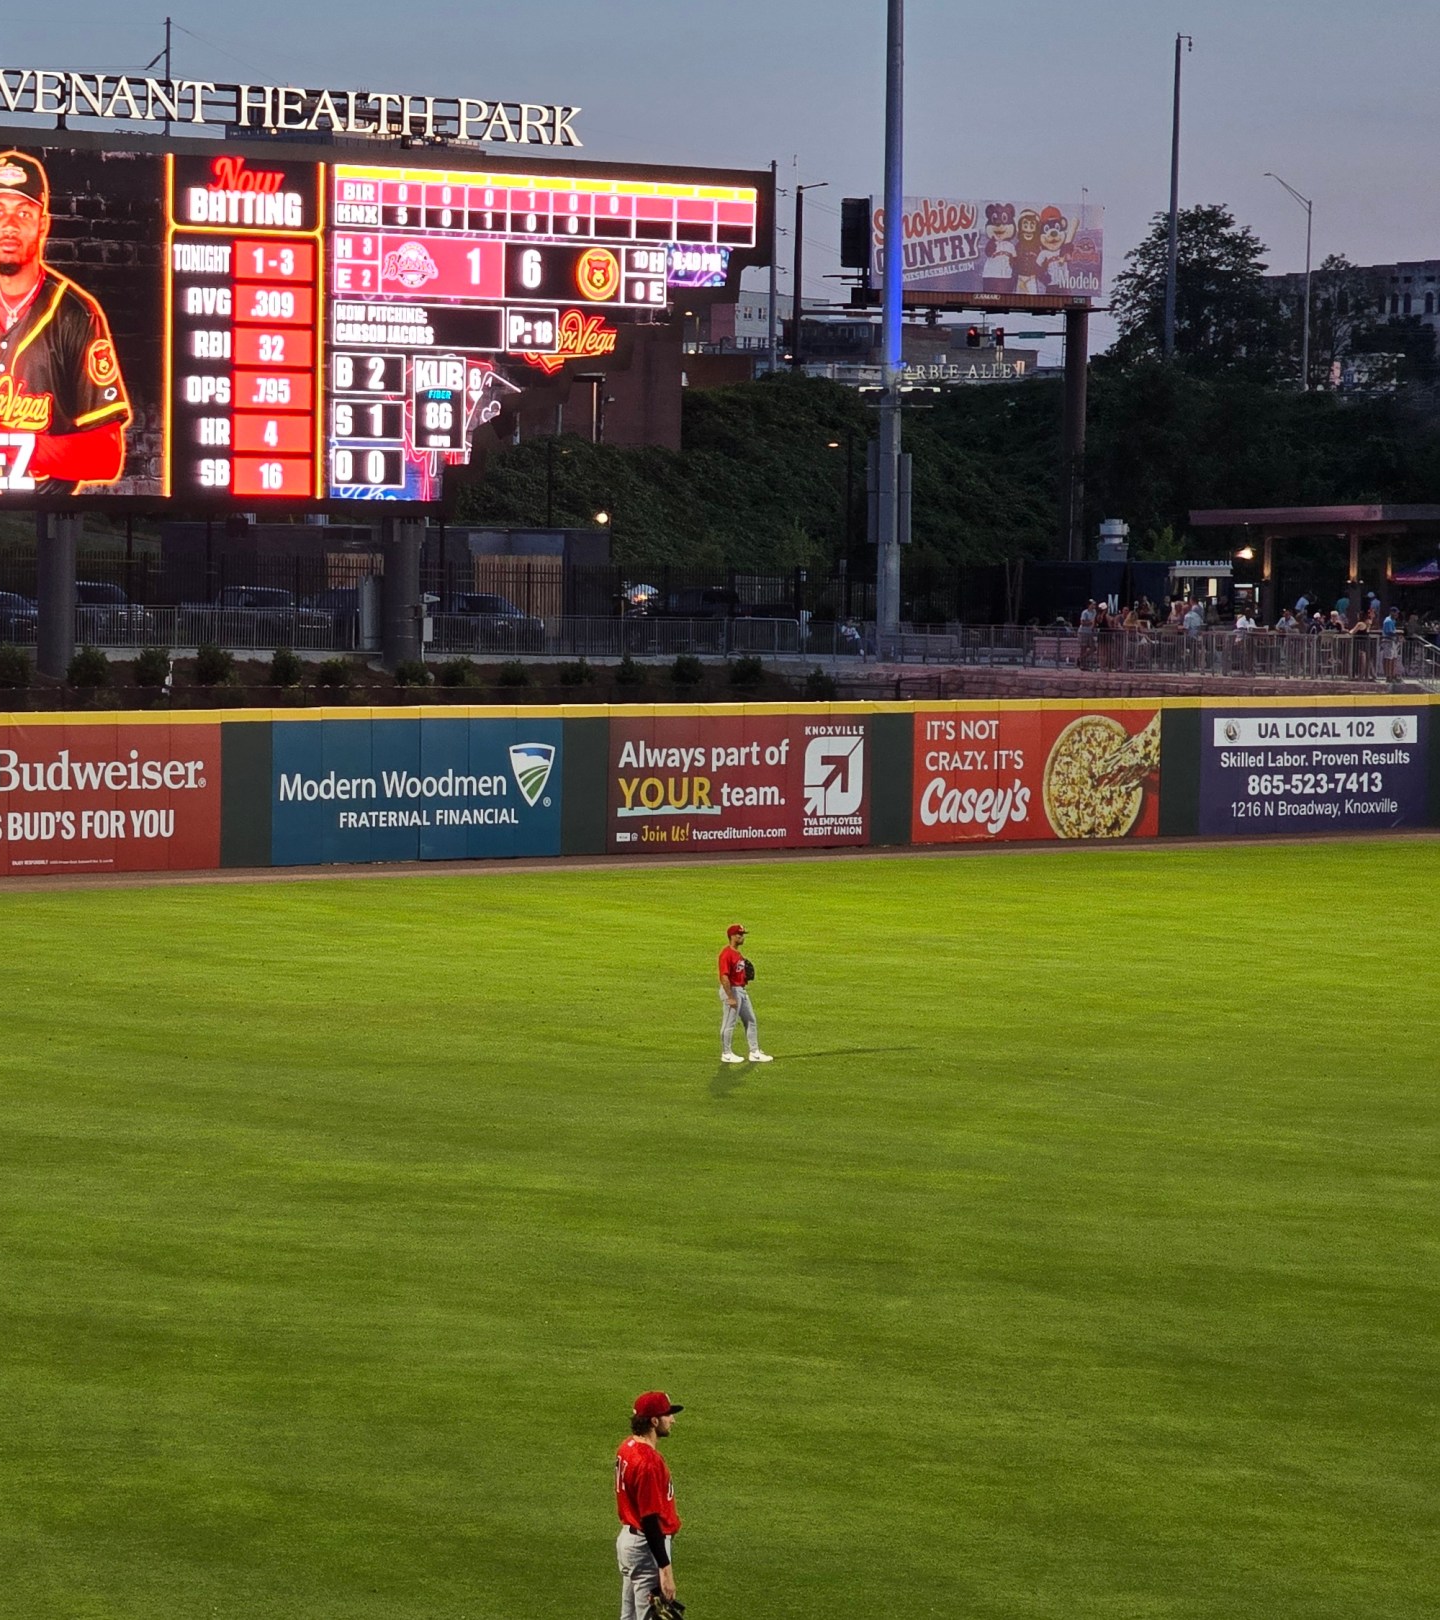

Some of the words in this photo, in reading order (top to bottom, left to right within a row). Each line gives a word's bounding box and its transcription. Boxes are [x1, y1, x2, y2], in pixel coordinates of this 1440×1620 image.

[239, 84, 435, 137] HEALTH
[457, 97, 584, 147] PARK
[208, 156, 284, 194] Now
[190, 187, 302, 226] BATTING
[343, 182, 374, 201] BIR
[398, 184, 408, 202] 0
[441, 186, 451, 205] 0
[485, 189, 494, 207] 0
[527, 191, 535, 209] 1
[569, 194, 578, 212] 0
[610, 196, 619, 214] 0
[338, 204, 378, 224] KNX
[397, 206, 408, 225] 5
[441, 209, 451, 227] 0
[483, 212, 492, 229] 1
[526, 213, 536, 232] 0
[568, 216, 578, 234] 0
[873, 199, 976, 246] Sokies
[173, 244, 231, 273] TONIGHT
[337, 238, 352, 258] H
[363, 237, 372, 255] 3
[632, 251, 648, 269] 10
[649, 252, 664, 272] H
[876, 232, 978, 275] CUNTRY
[337, 269, 351, 288] E
[362, 269, 371, 287] 2
[466, 248, 480, 285] 1
[522, 249, 542, 288] 6
[1058, 269, 1099, 290] Modelo
[188, 288, 231, 315] AVG
[250, 291, 294, 317] .309
[635, 281, 645, 300] 0
[649, 282, 664, 301] E
[336, 304, 366, 321] NOW
[367, 305, 428, 324] PITCHING:
[194, 331, 231, 358] RBI
[259, 335, 285, 361] 32
[336, 356, 353, 388] B
[368, 357, 385, 389] 2
[416, 360, 463, 390] KUB
[469, 368, 481, 389] 6
[905, 365, 959, 380] ARBLE
[967, 364, 1022, 378] ALLEY
[187, 376, 231, 403] OPS
[252, 378, 290, 404] .795
[336, 404, 353, 436] S
[369, 404, 383, 436] 1
[426, 402, 452, 429] 86
[200, 418, 230, 445] HR
[264, 420, 278, 447] 4
[200, 459, 230, 486] SB
[259, 462, 283, 489] 16
[805, 725, 865, 735] KNOXVILLE
[926, 720, 955, 740] IT'S
[961, 720, 999, 740] NOT
[1258, 723, 1280, 738] UA
[1286, 722, 1340, 738] LOCAL
[1346, 721, 1375, 737] 102
[618, 740, 705, 772] Always
[712, 741, 759, 772] part
[765, 738, 789, 766] of
[926, 751, 989, 771] CRAZY.
[993, 750, 1024, 769] IT'S
[1220, 752, 1264, 767] Skilled
[1268, 751, 1309, 767] Labor.
[1312, 750, 1359, 766] Proven
[1363, 749, 1410, 764] Results
[279, 771, 376, 801] Modern
[382, 769, 507, 798] Woodmen
[618, 776, 712, 810] YOUR
[721, 782, 786, 807] team.
[1247, 772, 1383, 795] 865-523-7413
[339, 810, 430, 828] FRATERNAL
[436, 808, 519, 826] FINANCIAL
[920, 777, 1031, 833] Casey's
[1231, 802, 1260, 817] 1216
[1264, 801, 1274, 816] N
[1278, 799, 1341, 818] Broadway,
[1345, 798, 1398, 814] Knoxville
[8, 811, 76, 841] BUD'S
[81, 810, 125, 839] FOR
[130, 809, 175, 838] YOU
[641, 825, 667, 842] Join
[671, 822, 690, 842] Us!
[692, 826, 786, 841] tvacreditunion.com
[803, 818, 818, 826] TVA
[819, 816, 862, 825] EMPLOYEES
[803, 827, 831, 836] CREDIT
[833, 826, 862, 835] UNION
